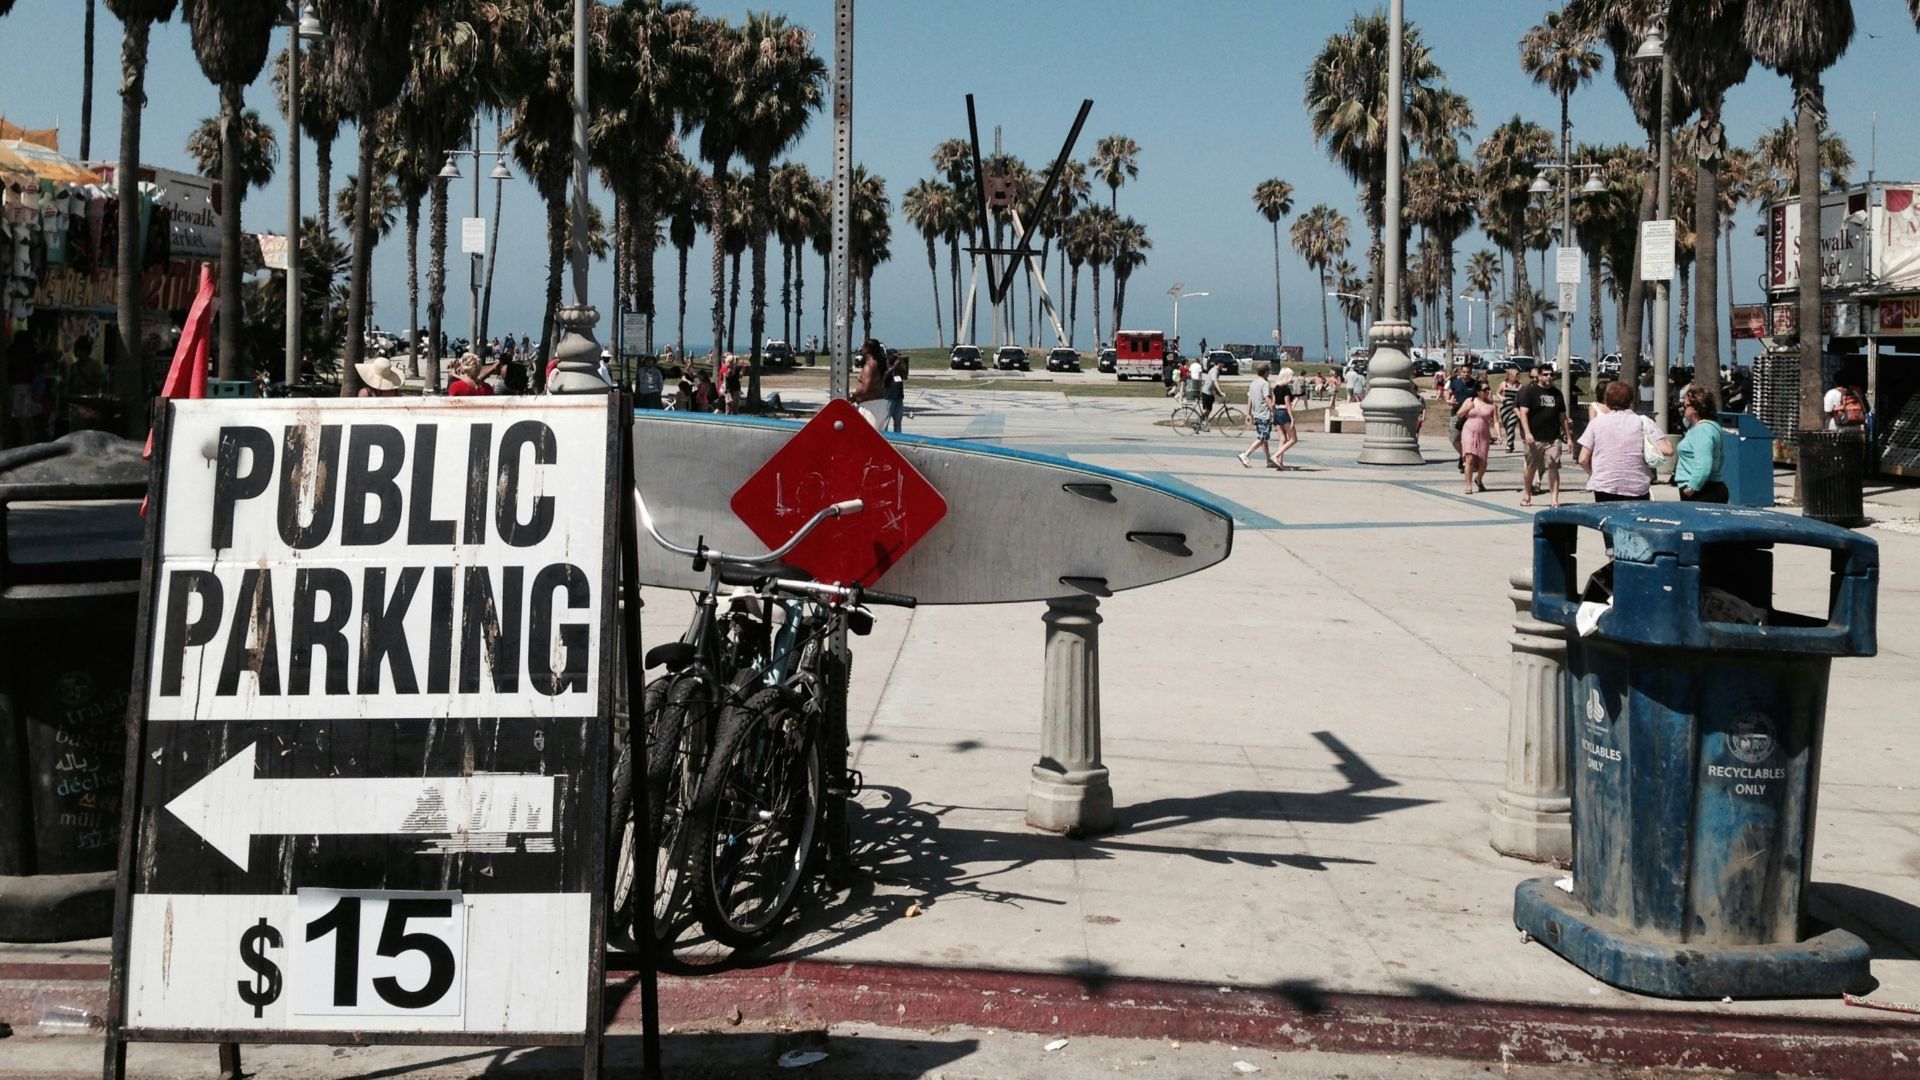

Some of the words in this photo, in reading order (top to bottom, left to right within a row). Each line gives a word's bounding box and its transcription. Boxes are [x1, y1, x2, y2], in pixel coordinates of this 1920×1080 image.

[171, 228, 206, 248] arket
[1774, 210, 1784, 278] VENICE
[1793, 228, 1854, 256] Swalk
[211, 420, 558, 550] PUBLIC
[160, 563, 591, 696] PARKING
[1708, 765, 1786, 779] RECYCLABLES
[1735, 783, 1767, 795] ONLY
